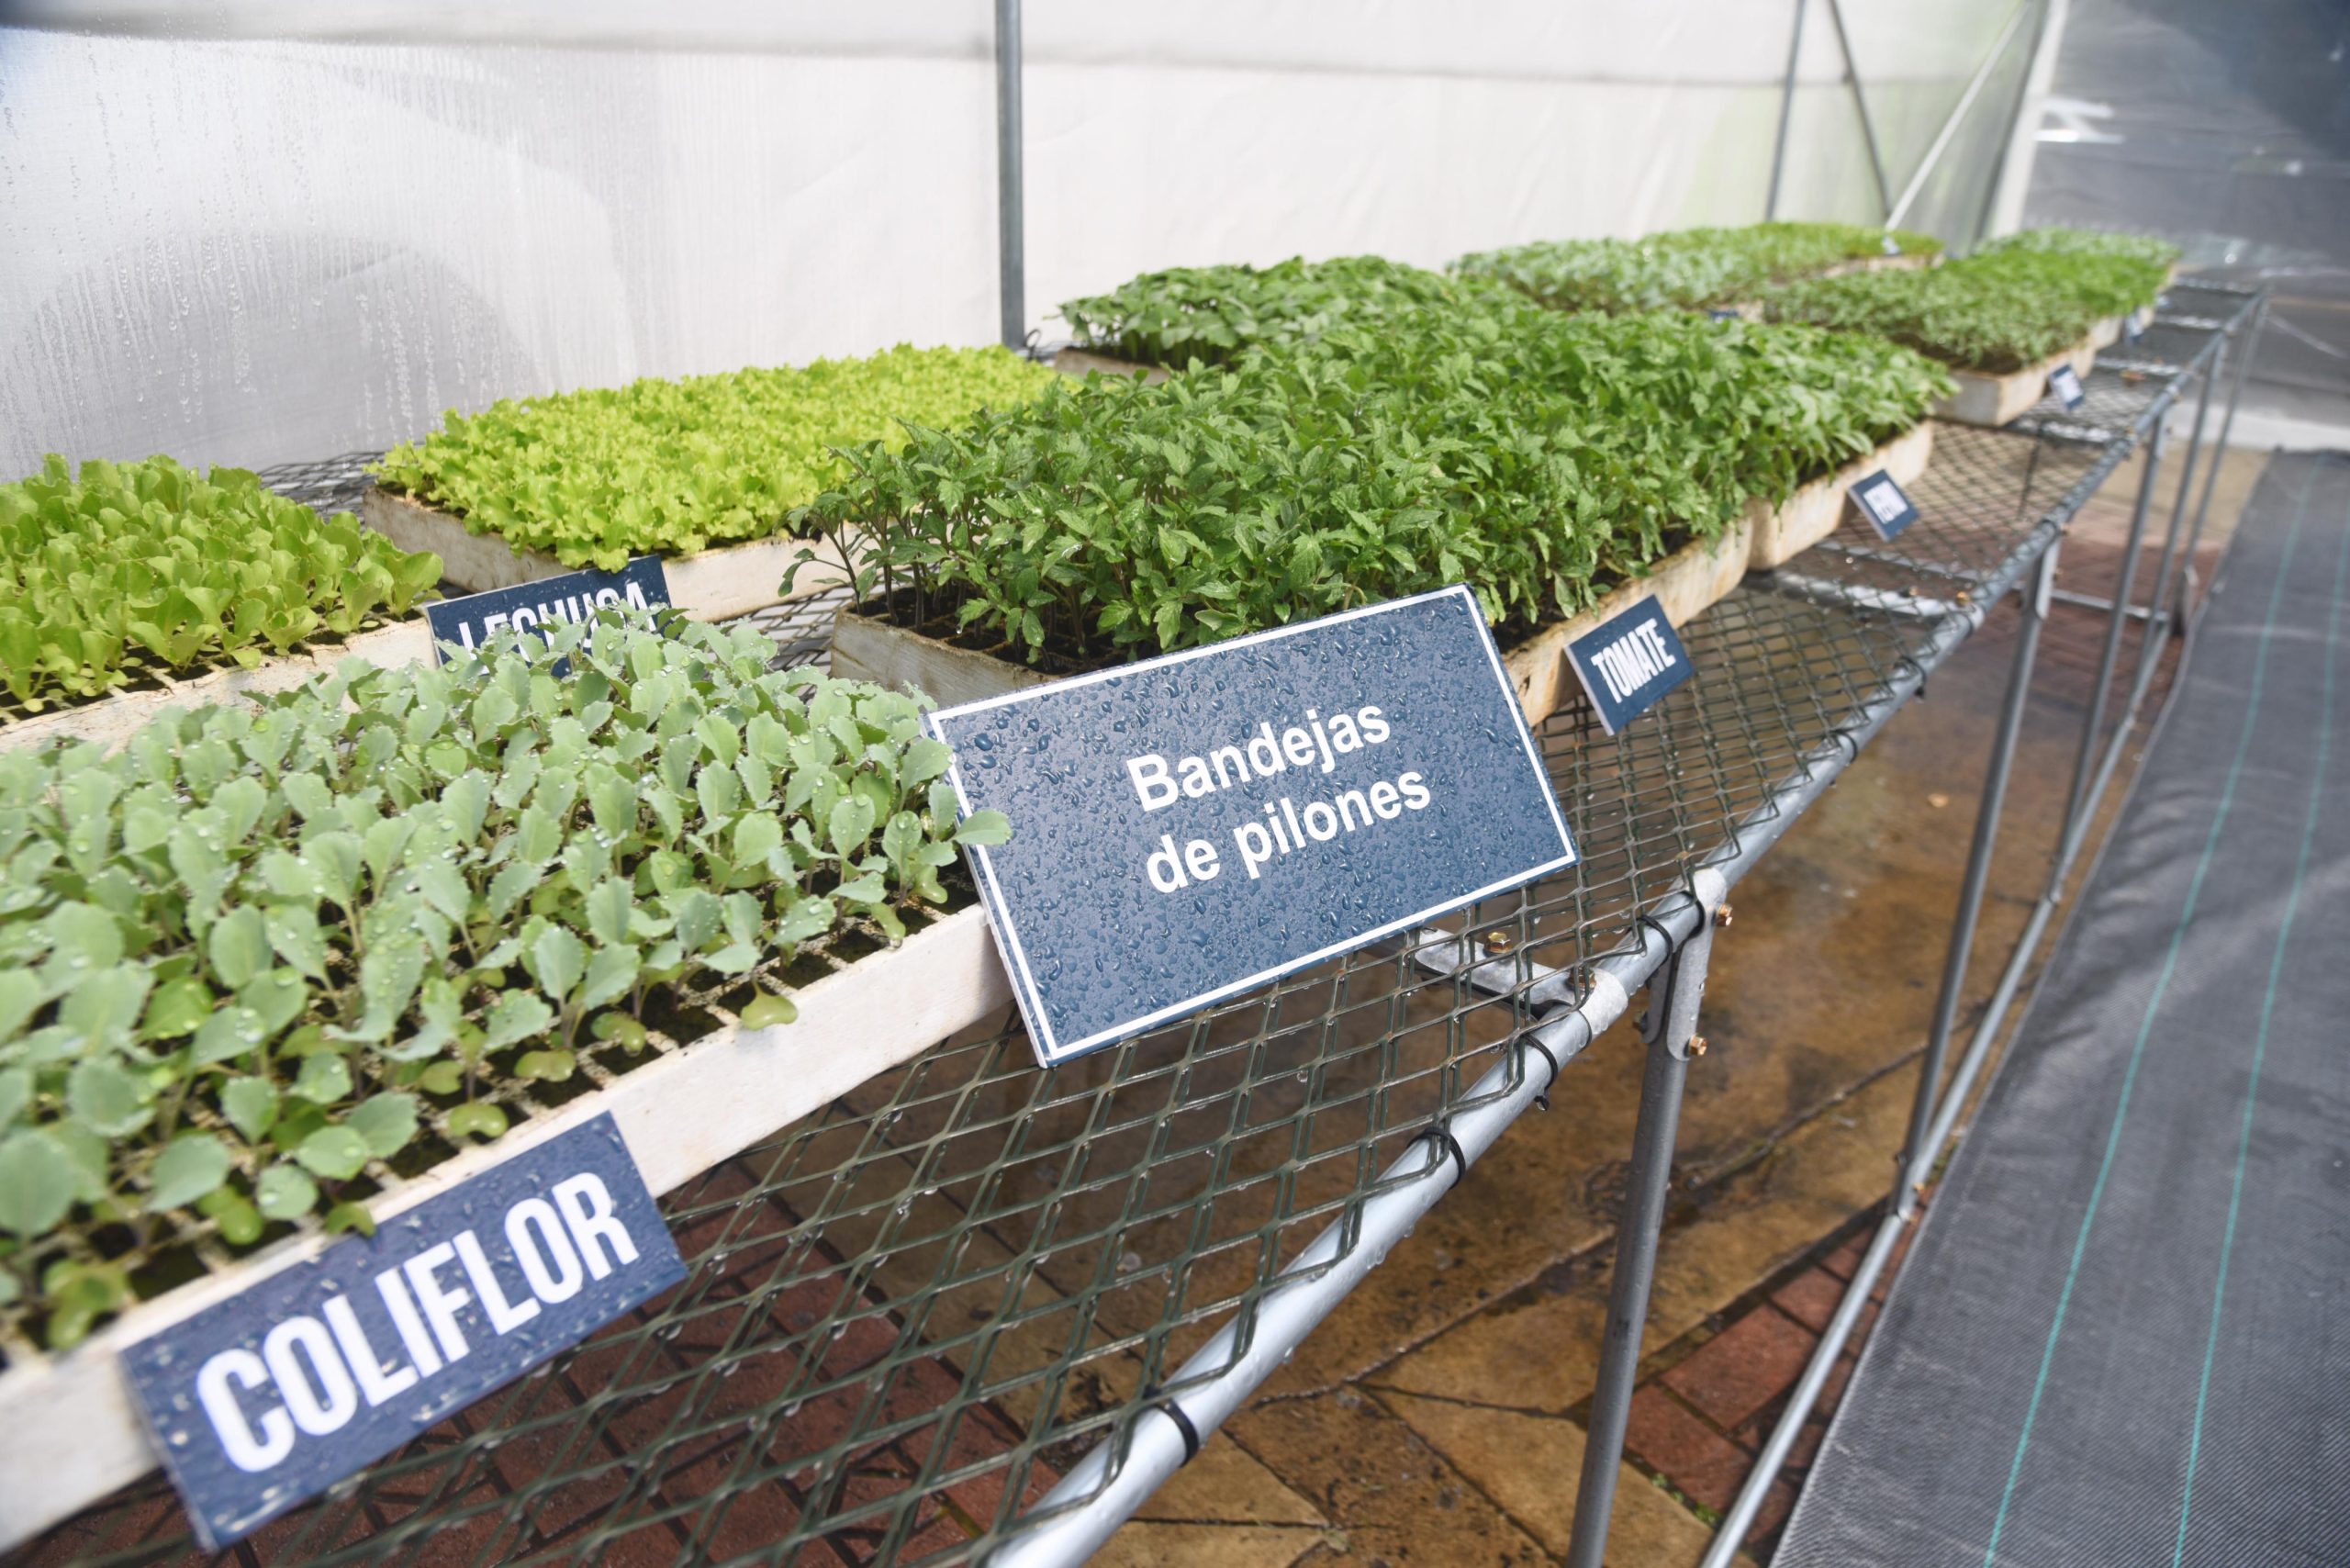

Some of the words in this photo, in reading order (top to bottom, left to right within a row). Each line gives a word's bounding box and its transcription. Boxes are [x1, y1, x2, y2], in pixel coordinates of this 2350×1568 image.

[1590, 618, 1676, 704] TOMATE
[1125, 705, 1391, 812] Bandejas
[1146, 834, 1221, 893] de
[1233, 770, 1431, 879] pilones
[196, 1172, 640, 1472] COLIFLOR
